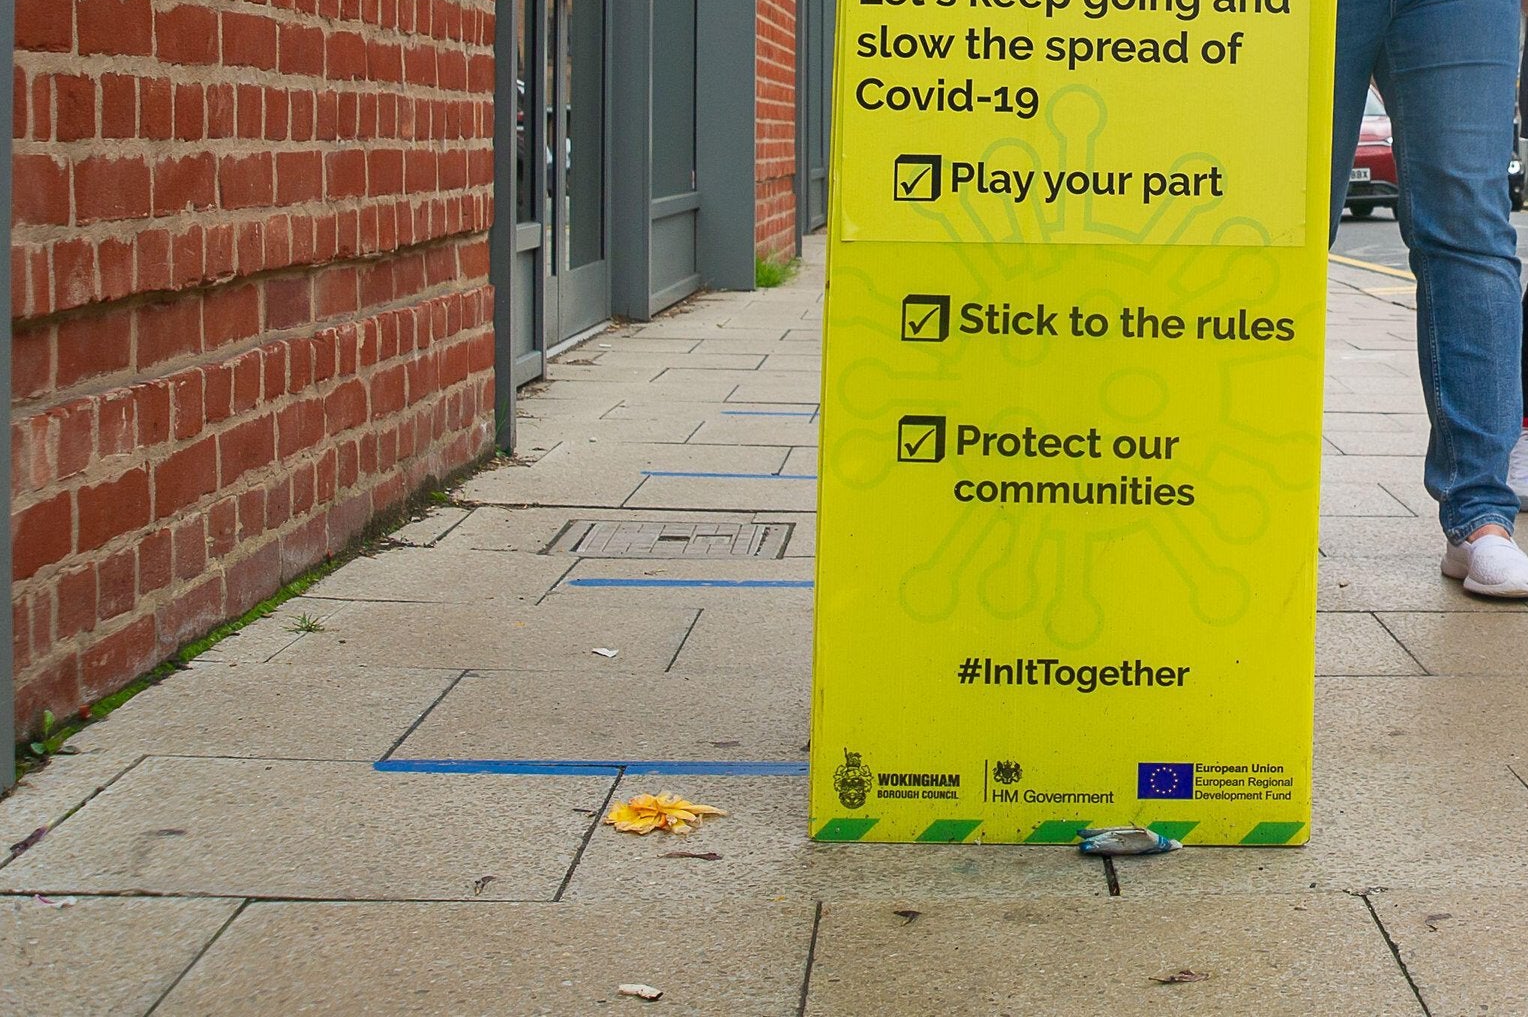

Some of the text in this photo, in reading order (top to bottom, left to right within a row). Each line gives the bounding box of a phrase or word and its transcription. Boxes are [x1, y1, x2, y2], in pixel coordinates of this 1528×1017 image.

[856, 24, 1245, 71] slow the spread of
[855, 77, 1039, 120] Covid-19
[951, 161, 1224, 205] Play your part
[959, 302, 1295, 342] Stick to the rules
[956, 424, 1180, 460] Protect our
[953, 475, 1195, 506] communities
[957, 657, 1191, 694] #InItTogether
[877, 772, 961, 788] WOKINGHAM
[1195, 762, 1284, 775] European Union
[1195, 776, 1293, 789] European Regional
[877, 789, 960, 800] BOROUGH COUNCIL
[992, 788, 1115, 804] HM Government
[1194, 790, 1292, 802] Development Fund
